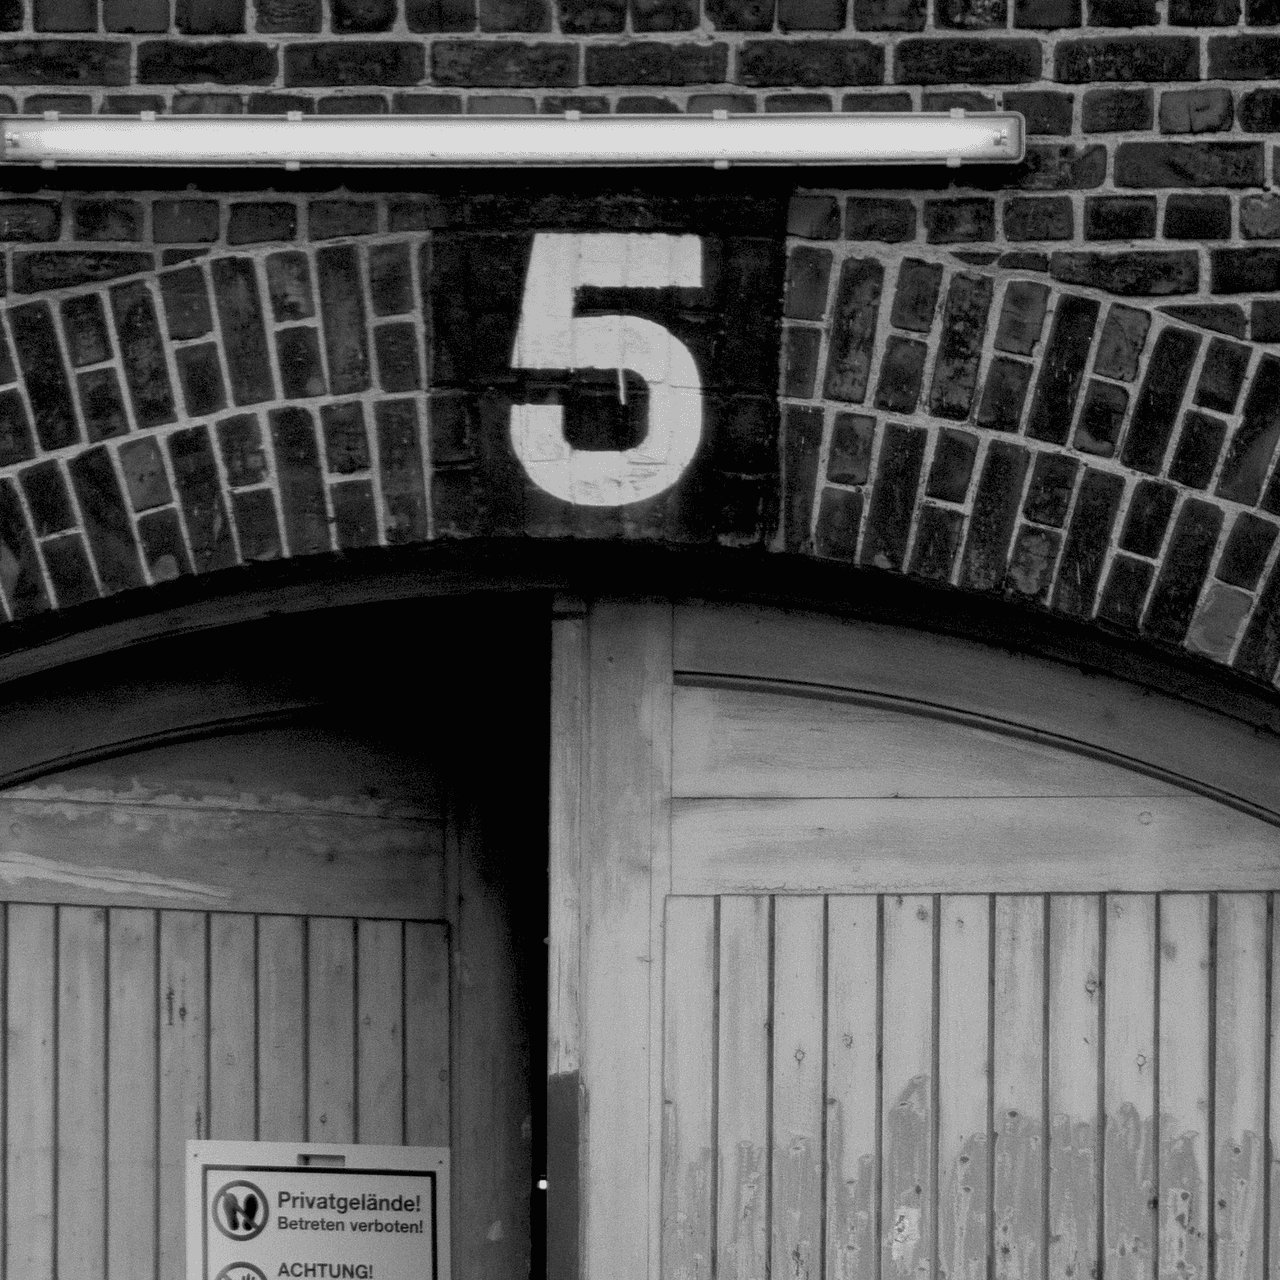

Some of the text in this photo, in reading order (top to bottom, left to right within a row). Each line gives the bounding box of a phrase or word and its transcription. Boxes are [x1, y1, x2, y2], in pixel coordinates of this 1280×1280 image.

[510, 233, 702, 506] 5
[278, 1191, 420, 1214] Privatgelände!
[278, 1216, 423, 1233] Betreten verboten!
[278, 1263, 373, 1279] ACHTUNG!
